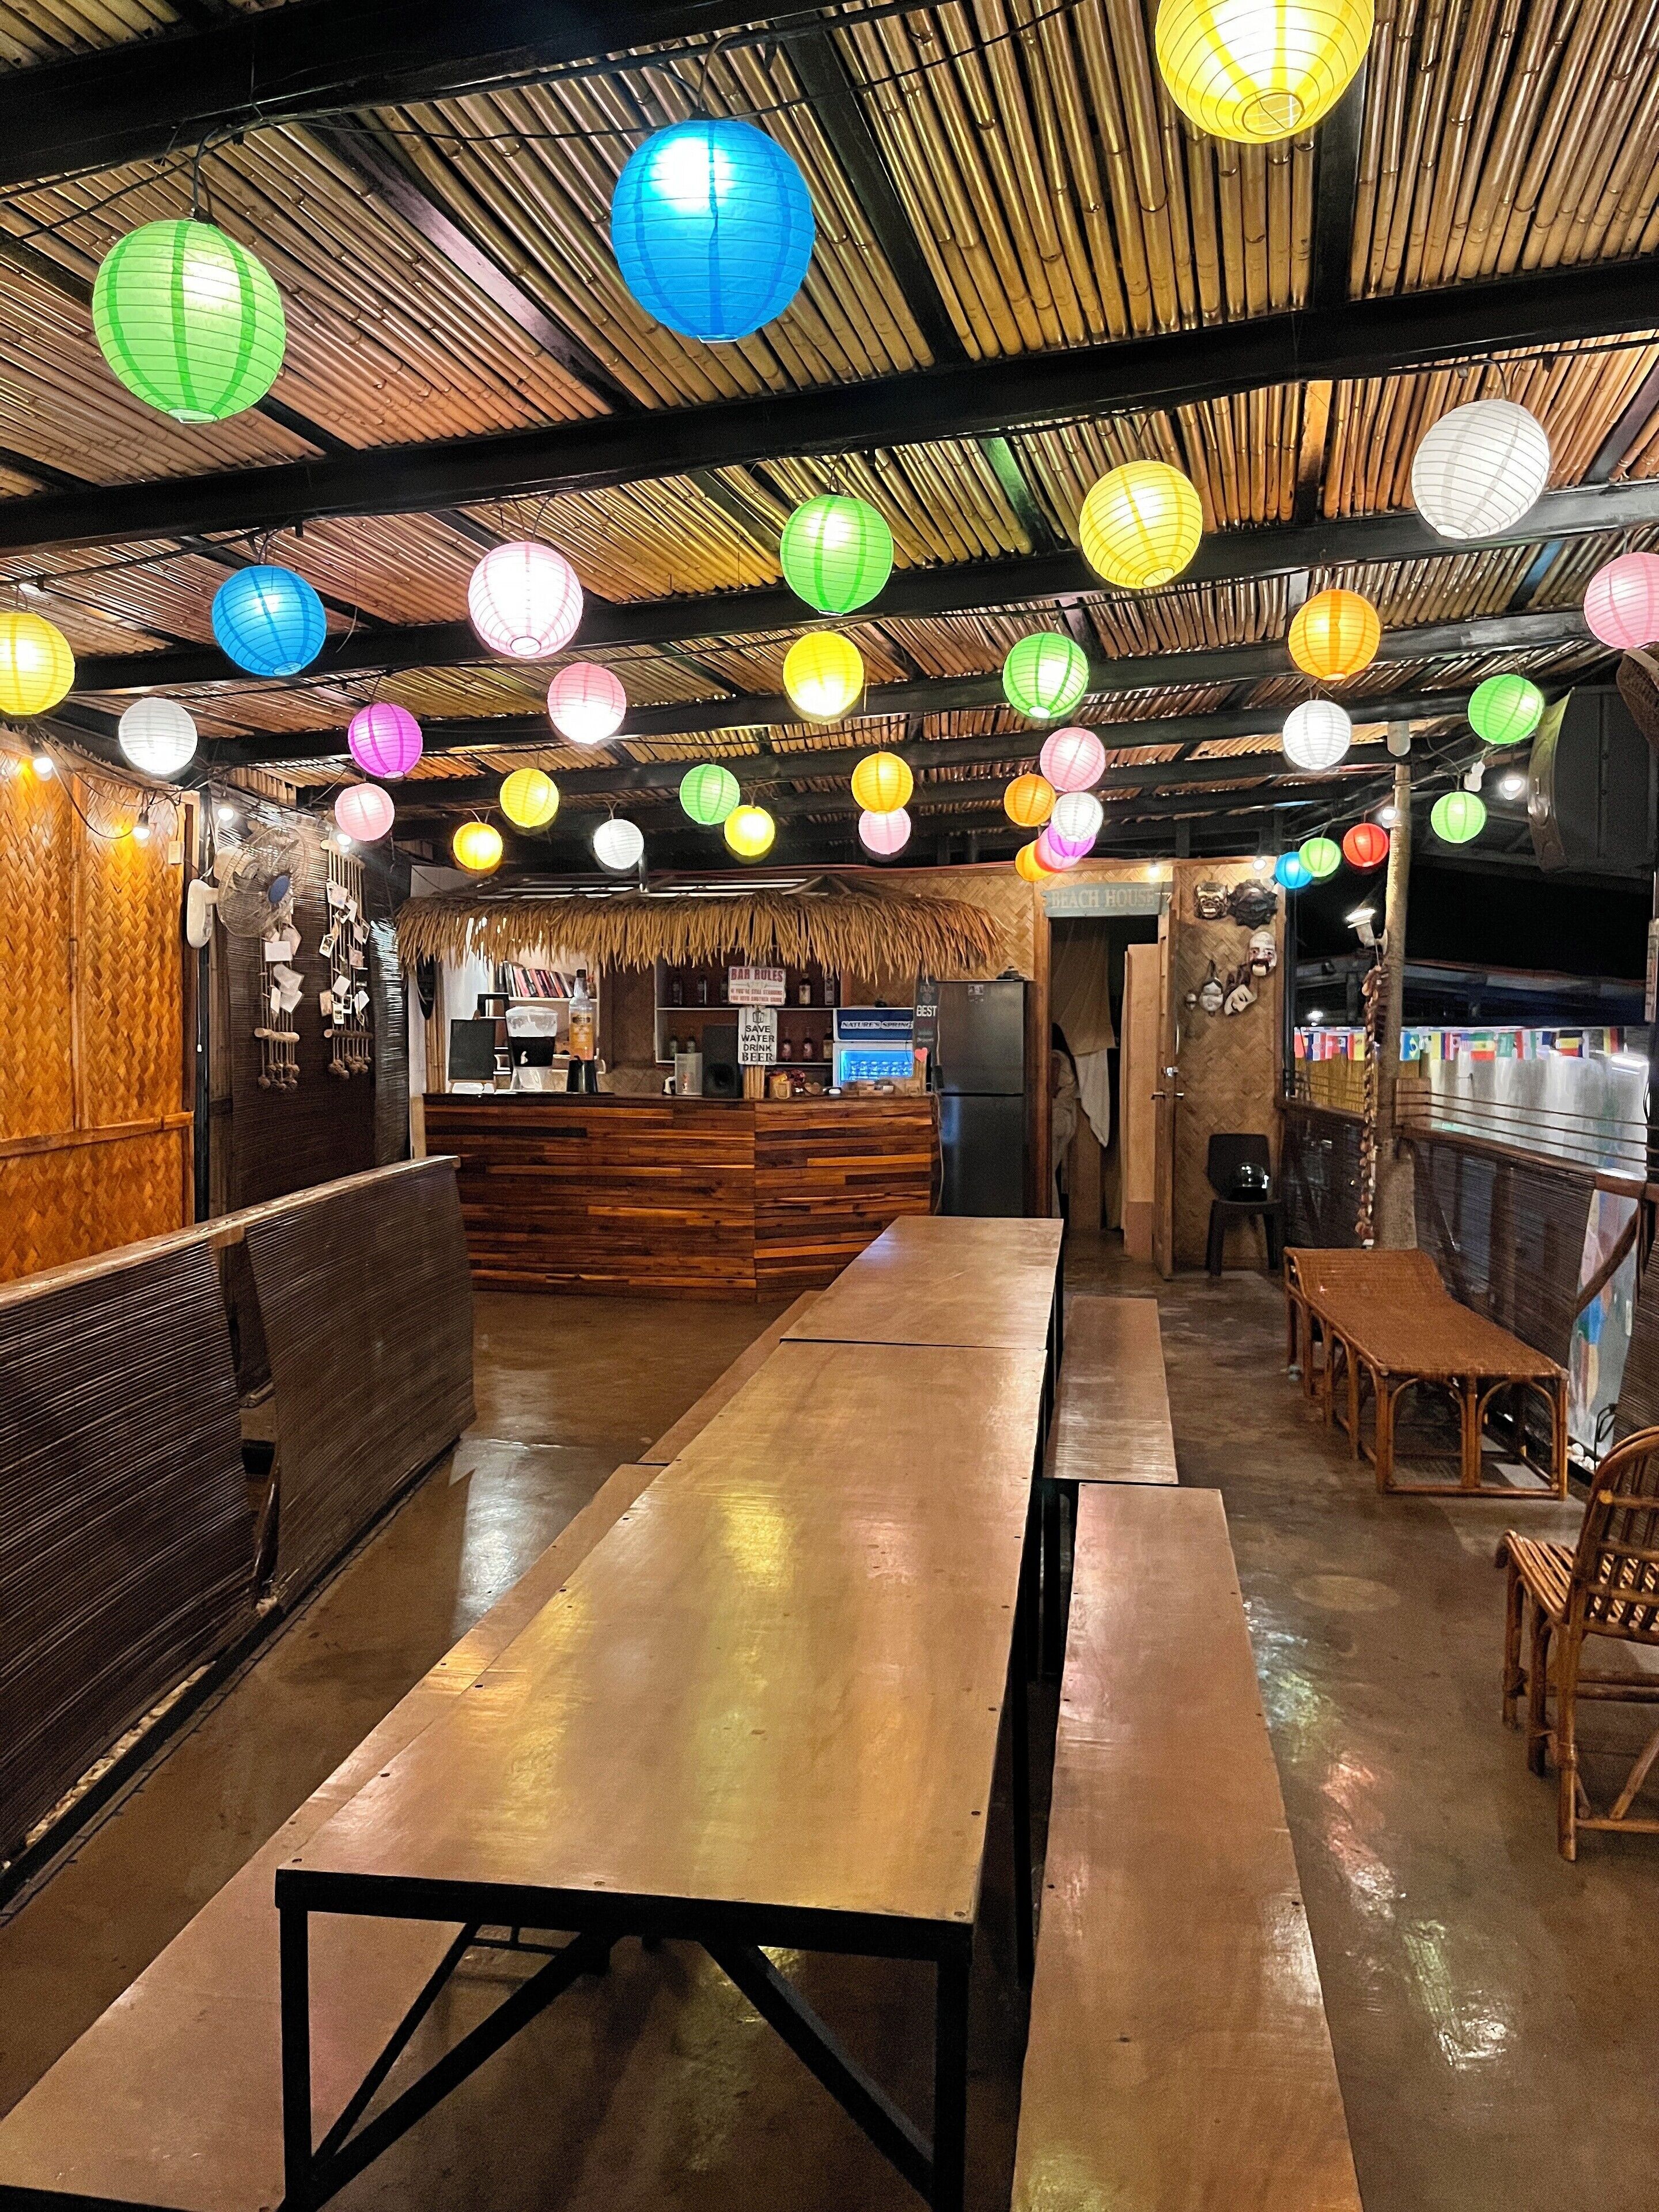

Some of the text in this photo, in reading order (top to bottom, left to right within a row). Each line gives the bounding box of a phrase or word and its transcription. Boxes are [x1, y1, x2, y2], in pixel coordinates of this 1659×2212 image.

[1051, 889, 1155, 908] BEACH HOUSE
[730, 968, 783, 982] BAR RULES
[916, 1005, 937, 1017] BEST
[745, 1025, 771, 1033] SAVE
[741, 1035, 775, 1043] WATER
[743, 1044, 772, 1052] DRINK
[742, 1052, 774, 1062] BEER
